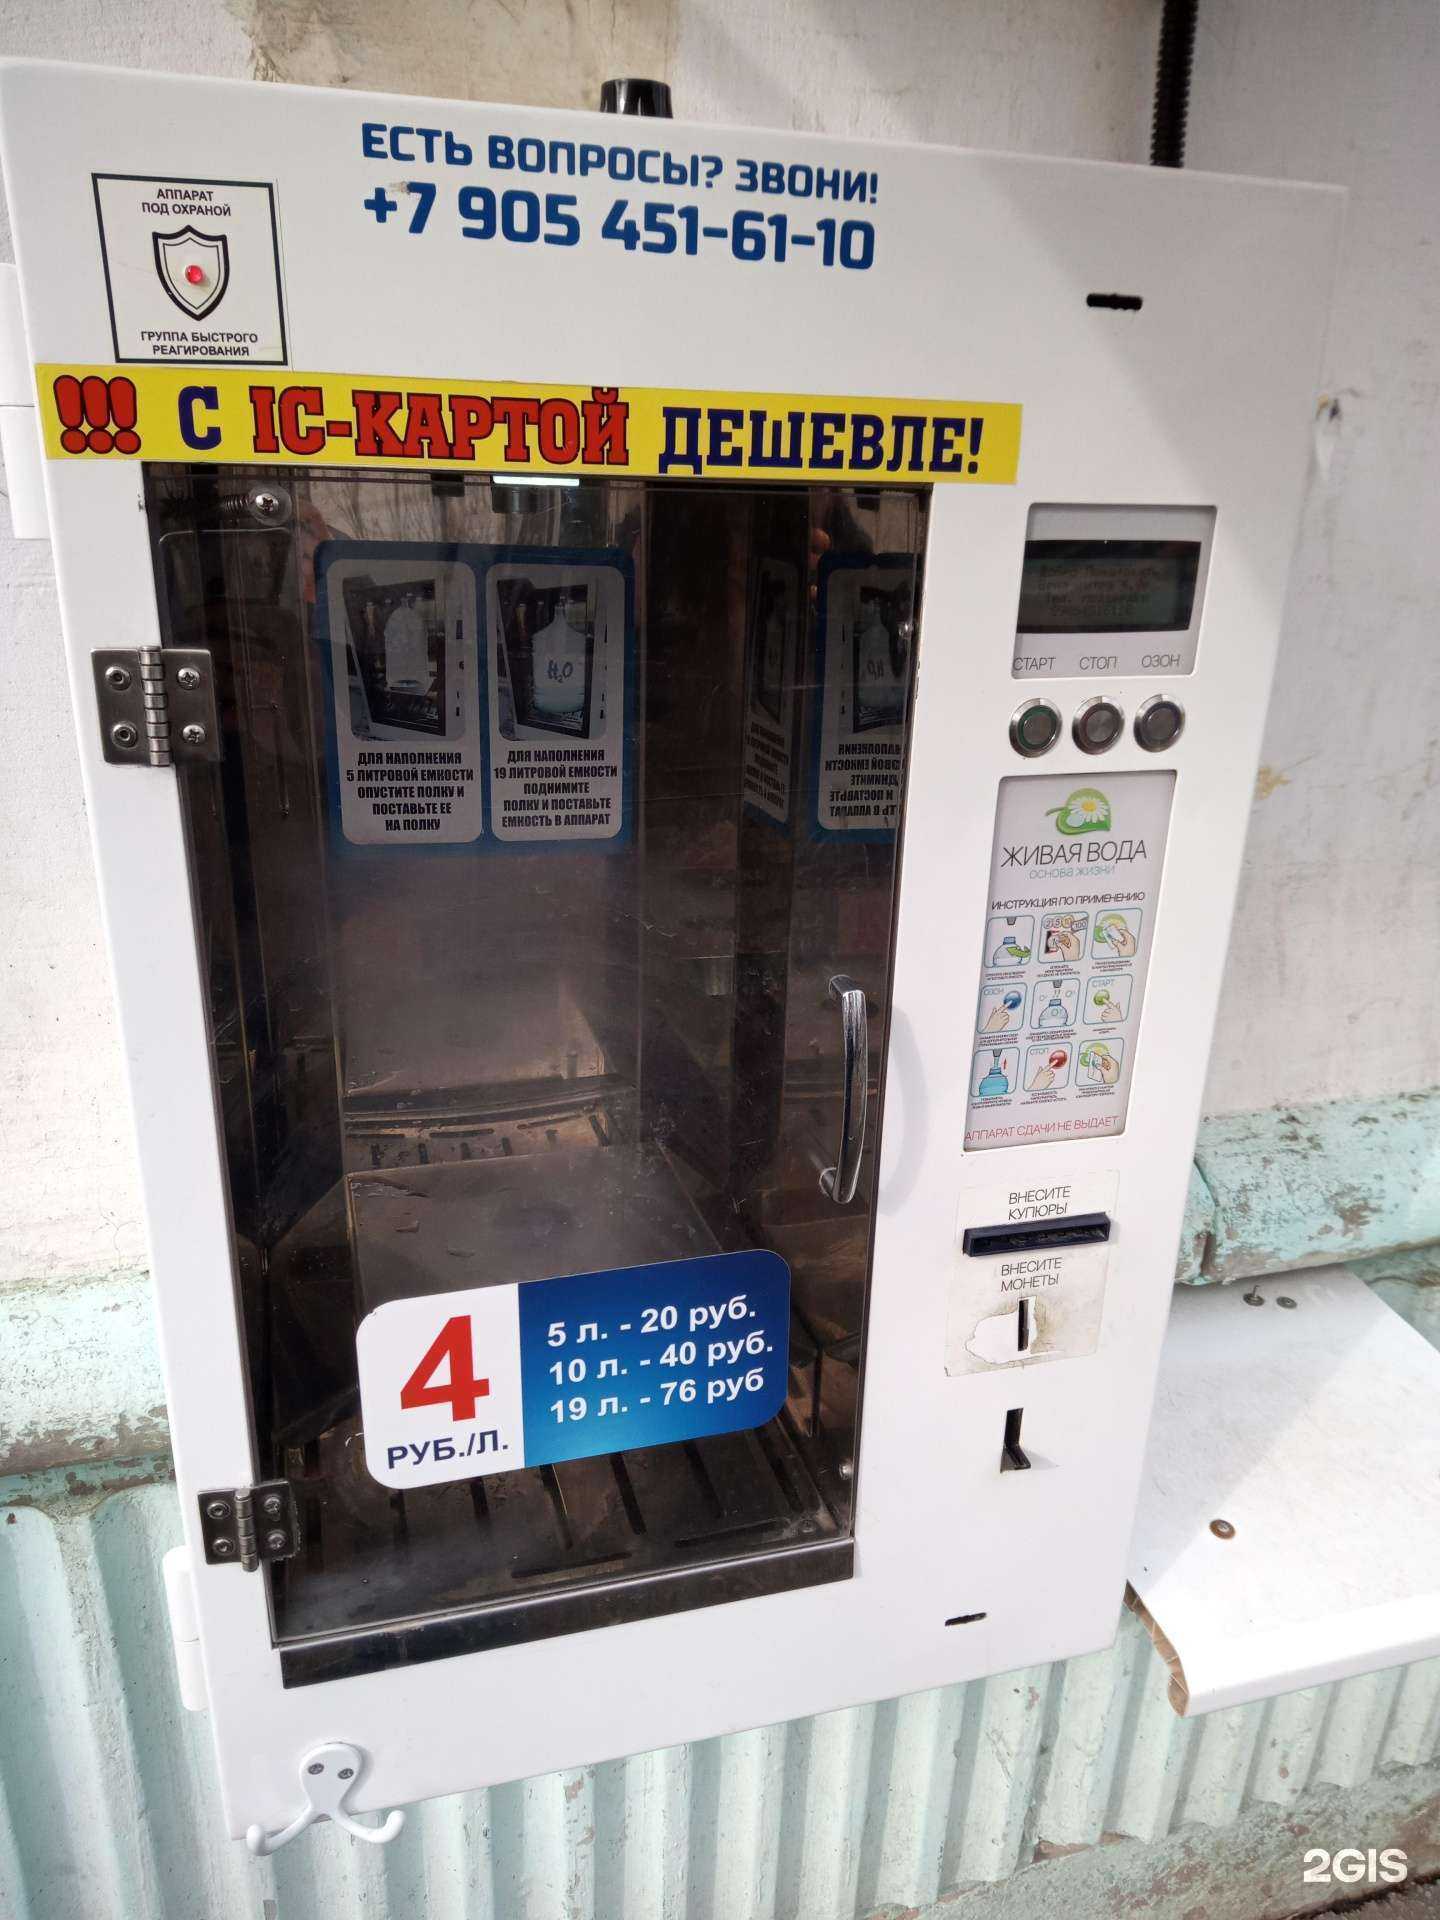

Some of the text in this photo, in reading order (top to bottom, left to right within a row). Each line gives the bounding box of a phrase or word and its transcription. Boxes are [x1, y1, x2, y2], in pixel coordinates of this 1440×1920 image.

[362, 123, 878, 203] ЕСТЬ ВОПРОСЫ? ЗВОНИ!
[156, 188, 214, 202] АППАРАТ
[142, 202, 231, 217] ПОД ОХРАНОЙ
[364, 181, 875, 270] +7 905 451-61-10
[141, 331, 258, 343] ГРУППА БЫСТРОГО
[153, 345, 250, 356] РЕАГИРОВАНИЯ
[178, 385, 222, 451] С
[658, 405, 984, 475] ДЕШЕВЛЕ!
[1012, 654, 1181, 671] СТАРТ СТОП ОЗОН
[358, 752, 462, 766] ДЛЯ НАПОЛНЕНИЯ
[507, 749, 605, 764] ДЛЯ НАПОЛНЕНИЯ
[346, 767, 474, 782] 5 ЛИТРОВОЙ ЕМКОСТИ
[494, 765, 618, 779] 19 ЛИТРОВОЙ ЕМКОСТИ
[357, 786, 415, 799] ОПУСТИТЕ
[457, 786, 465, 798] И
[523, 782, 590, 796] ПОДНИМИТЕ
[372, 802, 452, 815] ПОСТАВЬТЕ ЕЕ
[541, 799, 549, 811] И
[551, 797, 611, 810] ПОСТАВЬТЕ
[385, 819, 401, 831] НА
[502, 813, 611, 828] ЕМКОСТЬ В АППАРАТ
[1001, 840, 1147, 867] ЖИВАЯ ВОДА
[991, 891, 1146, 911] ИНСТРУКЦИЯ ПО ПРИМЕНЕНИЮ
[965, 1115, 1120, 1142] АППАРАТ СДАЧИ НЕ ВЫДАЕТ
[1009, 1186, 1071, 1205] ВНЕСИТЕ
[1008, 1202, 1068, 1221] КУПЮРЫ
[1001, 1257, 1063, 1276] ВНЕСИТЕ
[1000, 1273, 1060, 1292] МОНЕТЫ
[547, 1321, 567, 1347] 5
[576, 1322, 608, 1344] л.
[641, 1304, 679, 1334] 20
[689, 1294, 756, 1333] руб.
[549, 1359, 587, 1386] 10
[597, 1357, 628, 1379] л.
[659, 1342, 697, 1368] 40
[707, 1330, 774, 1367] руб.
[400, 1314, 490, 1422] 4
[550, 1396, 588, 1424] 19
[597, 1395, 628, 1417] л.
[662, 1380, 697, 1406] 76
[707, 1368, 765, 1404] руб
[387, 1429, 509, 1469] РУБ./Л.
